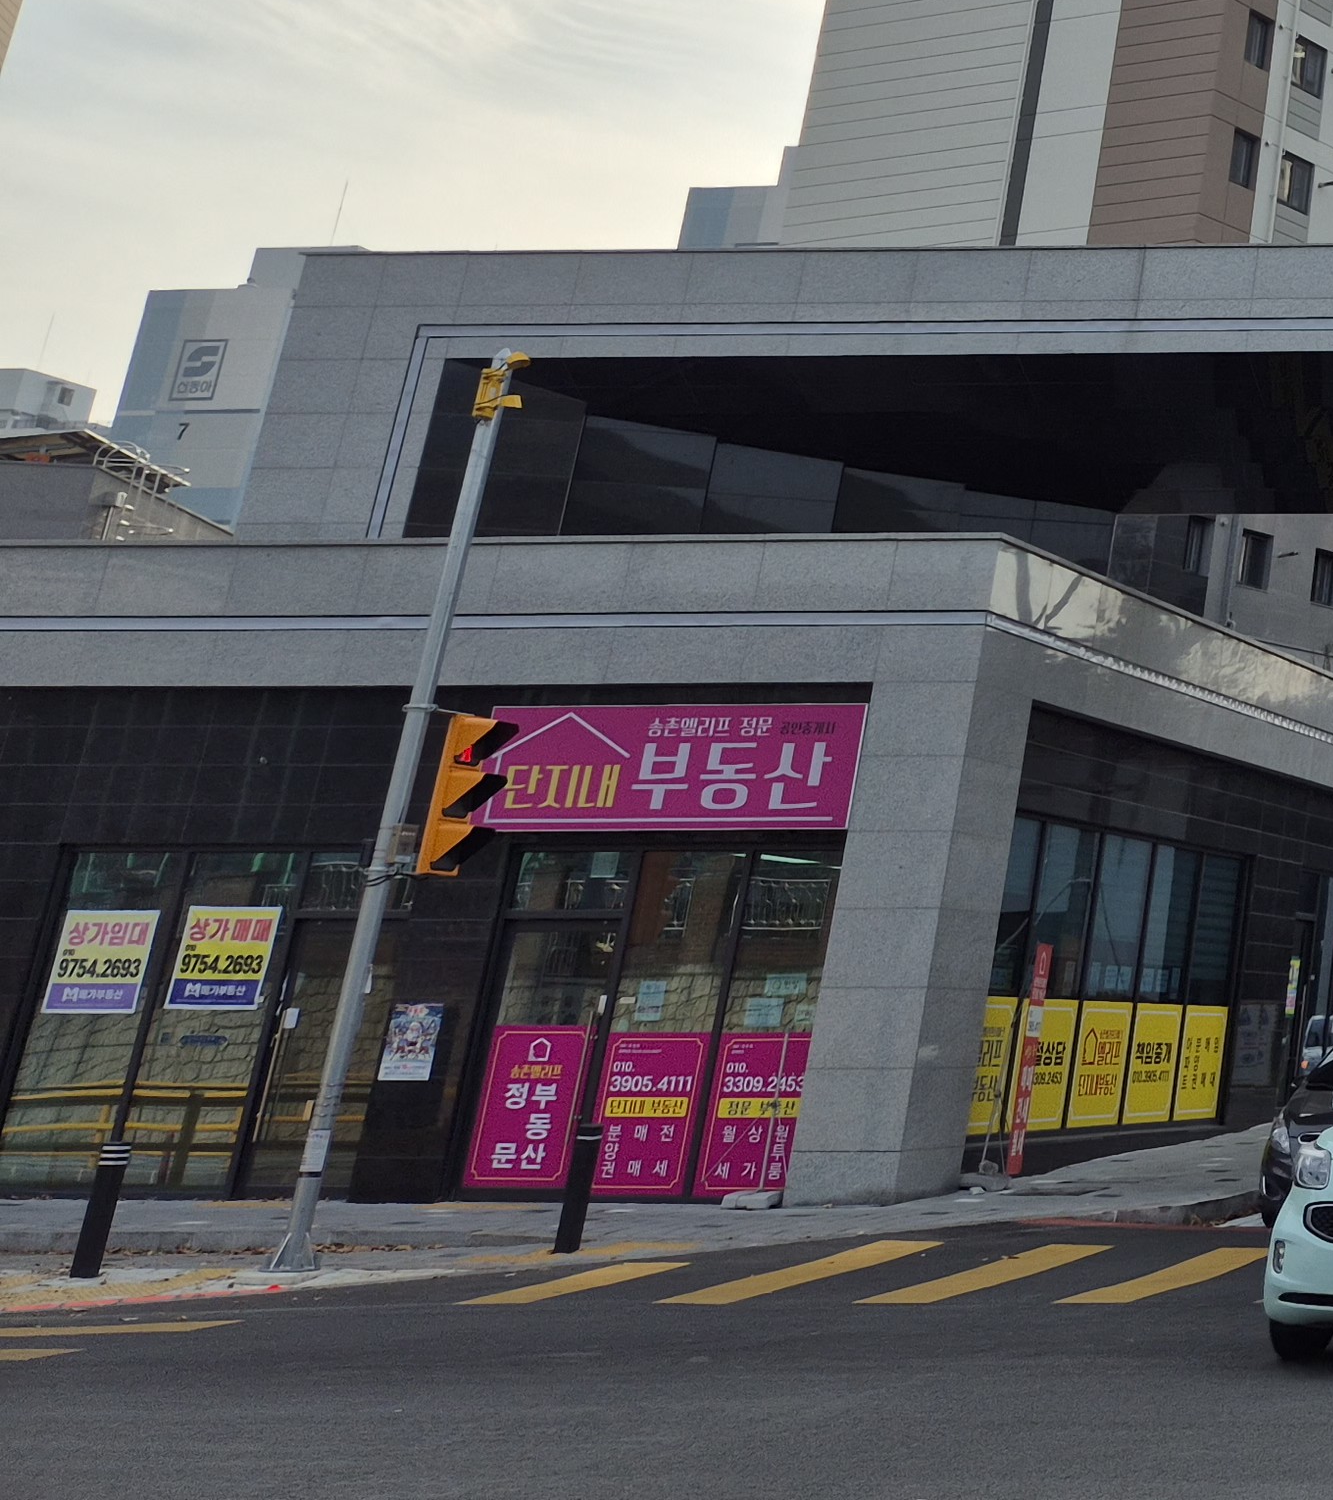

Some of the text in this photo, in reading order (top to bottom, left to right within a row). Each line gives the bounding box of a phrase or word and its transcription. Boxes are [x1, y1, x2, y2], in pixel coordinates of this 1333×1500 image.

[176, 422, 190, 441] 7
[647, 717, 731, 738] 송촌엘리프
[738, 717, 773, 738] 정문
[504, 741, 833, 811] 단지내 부동산
[68, 921, 150, 947] 상가임대
[57, 958, 142, 978] 9754.2693
[180, 953, 264, 975] 9754.2693
[1135, 1041, 1173, 1065] 책임중개
[613, 1062, 635, 1073] 010.
[726, 1062, 749, 1073] 010.
[609, 1075, 693, 1092] 3905.4111
[722, 1076, 804, 1092] 3309.2453
[609, 1099, 684, 1115] 단지내 부동산
[727, 1100, 752, 1116] 정문
[520, 1083, 558, 1170] 부동산
